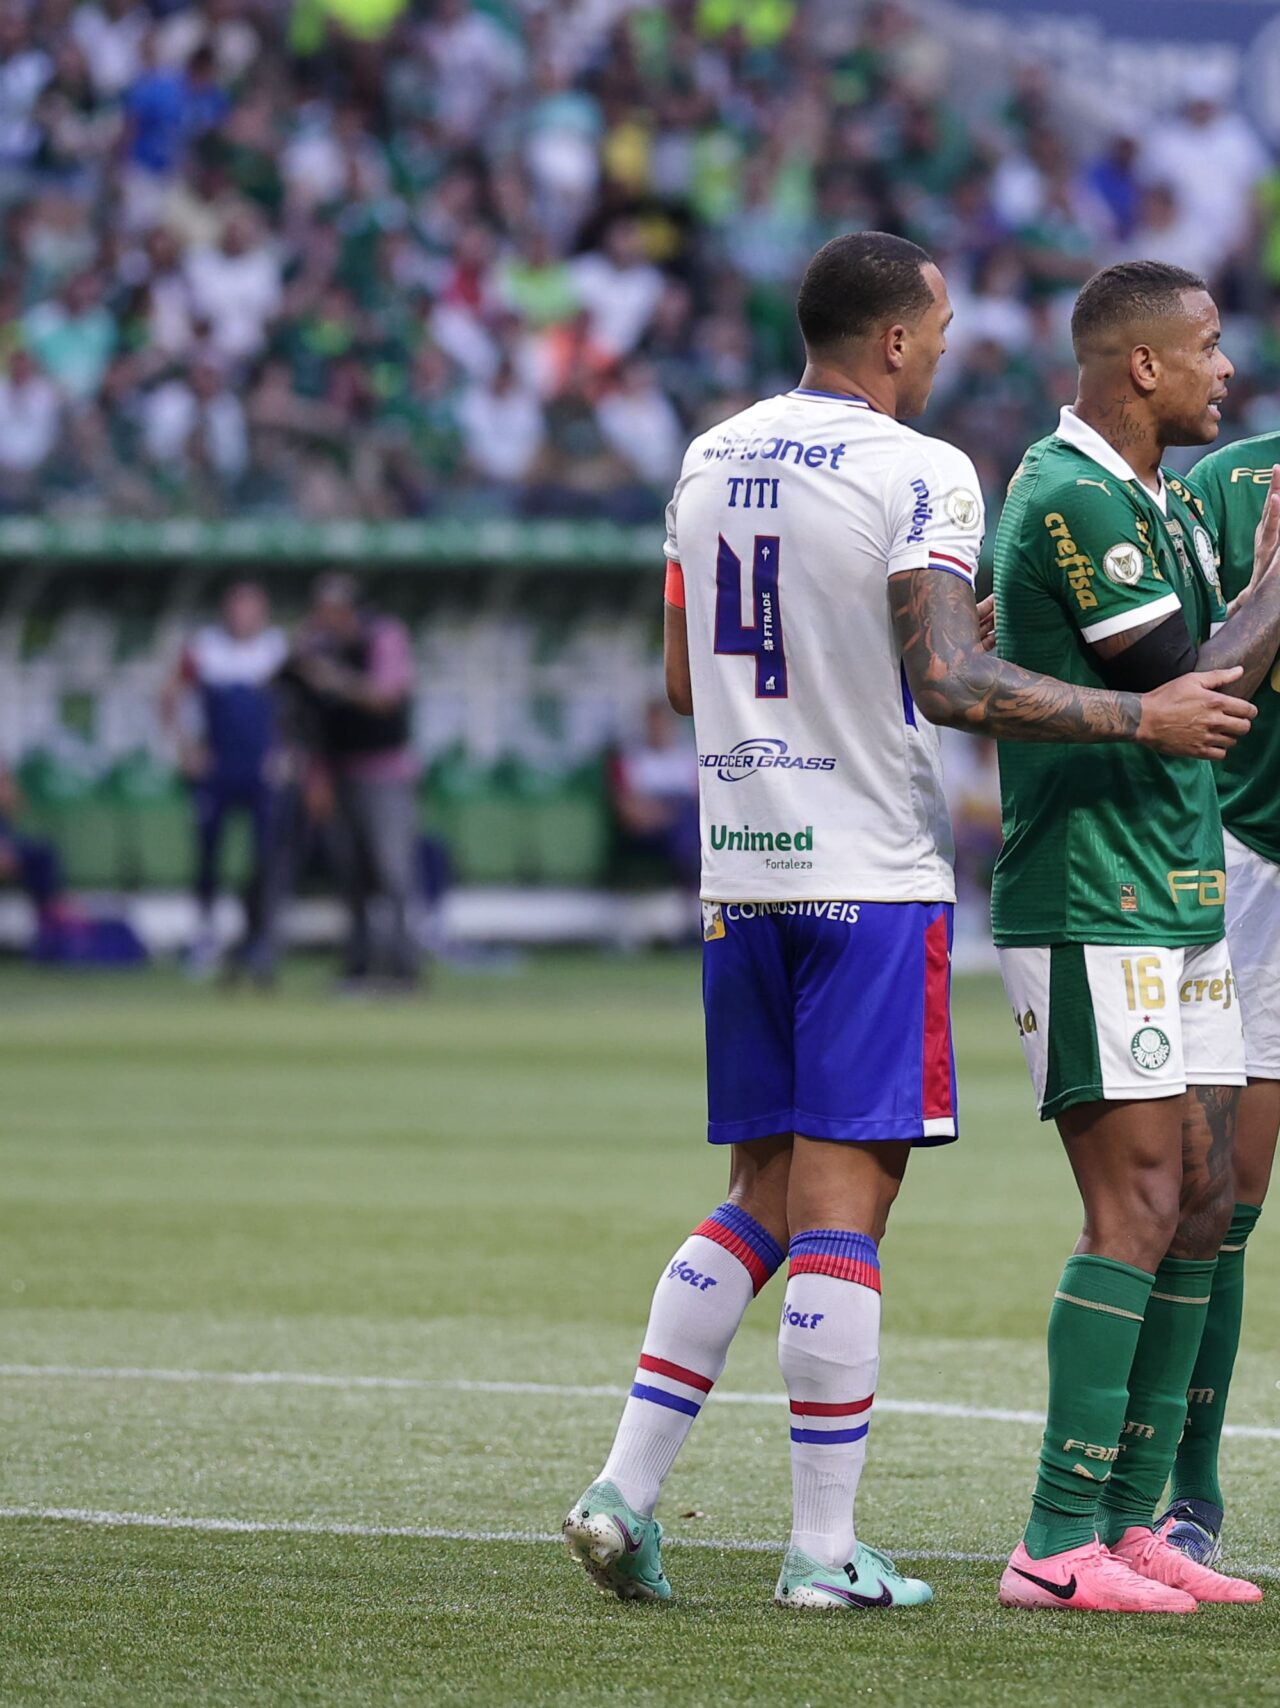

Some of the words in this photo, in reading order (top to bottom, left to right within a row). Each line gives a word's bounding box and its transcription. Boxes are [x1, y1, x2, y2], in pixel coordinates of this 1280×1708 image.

[727, 477, 780, 509] TITI
[1043, 512, 1098, 610] crefisa
[714, 532, 788, 698] 4
[699, 754, 754, 768] SOCCER
[756, 755, 837, 771] GRASS
[710, 825, 813, 852] Unimed
[765, 859, 813, 870] Fortaleza
[1120, 956, 1166, 1011] 16
